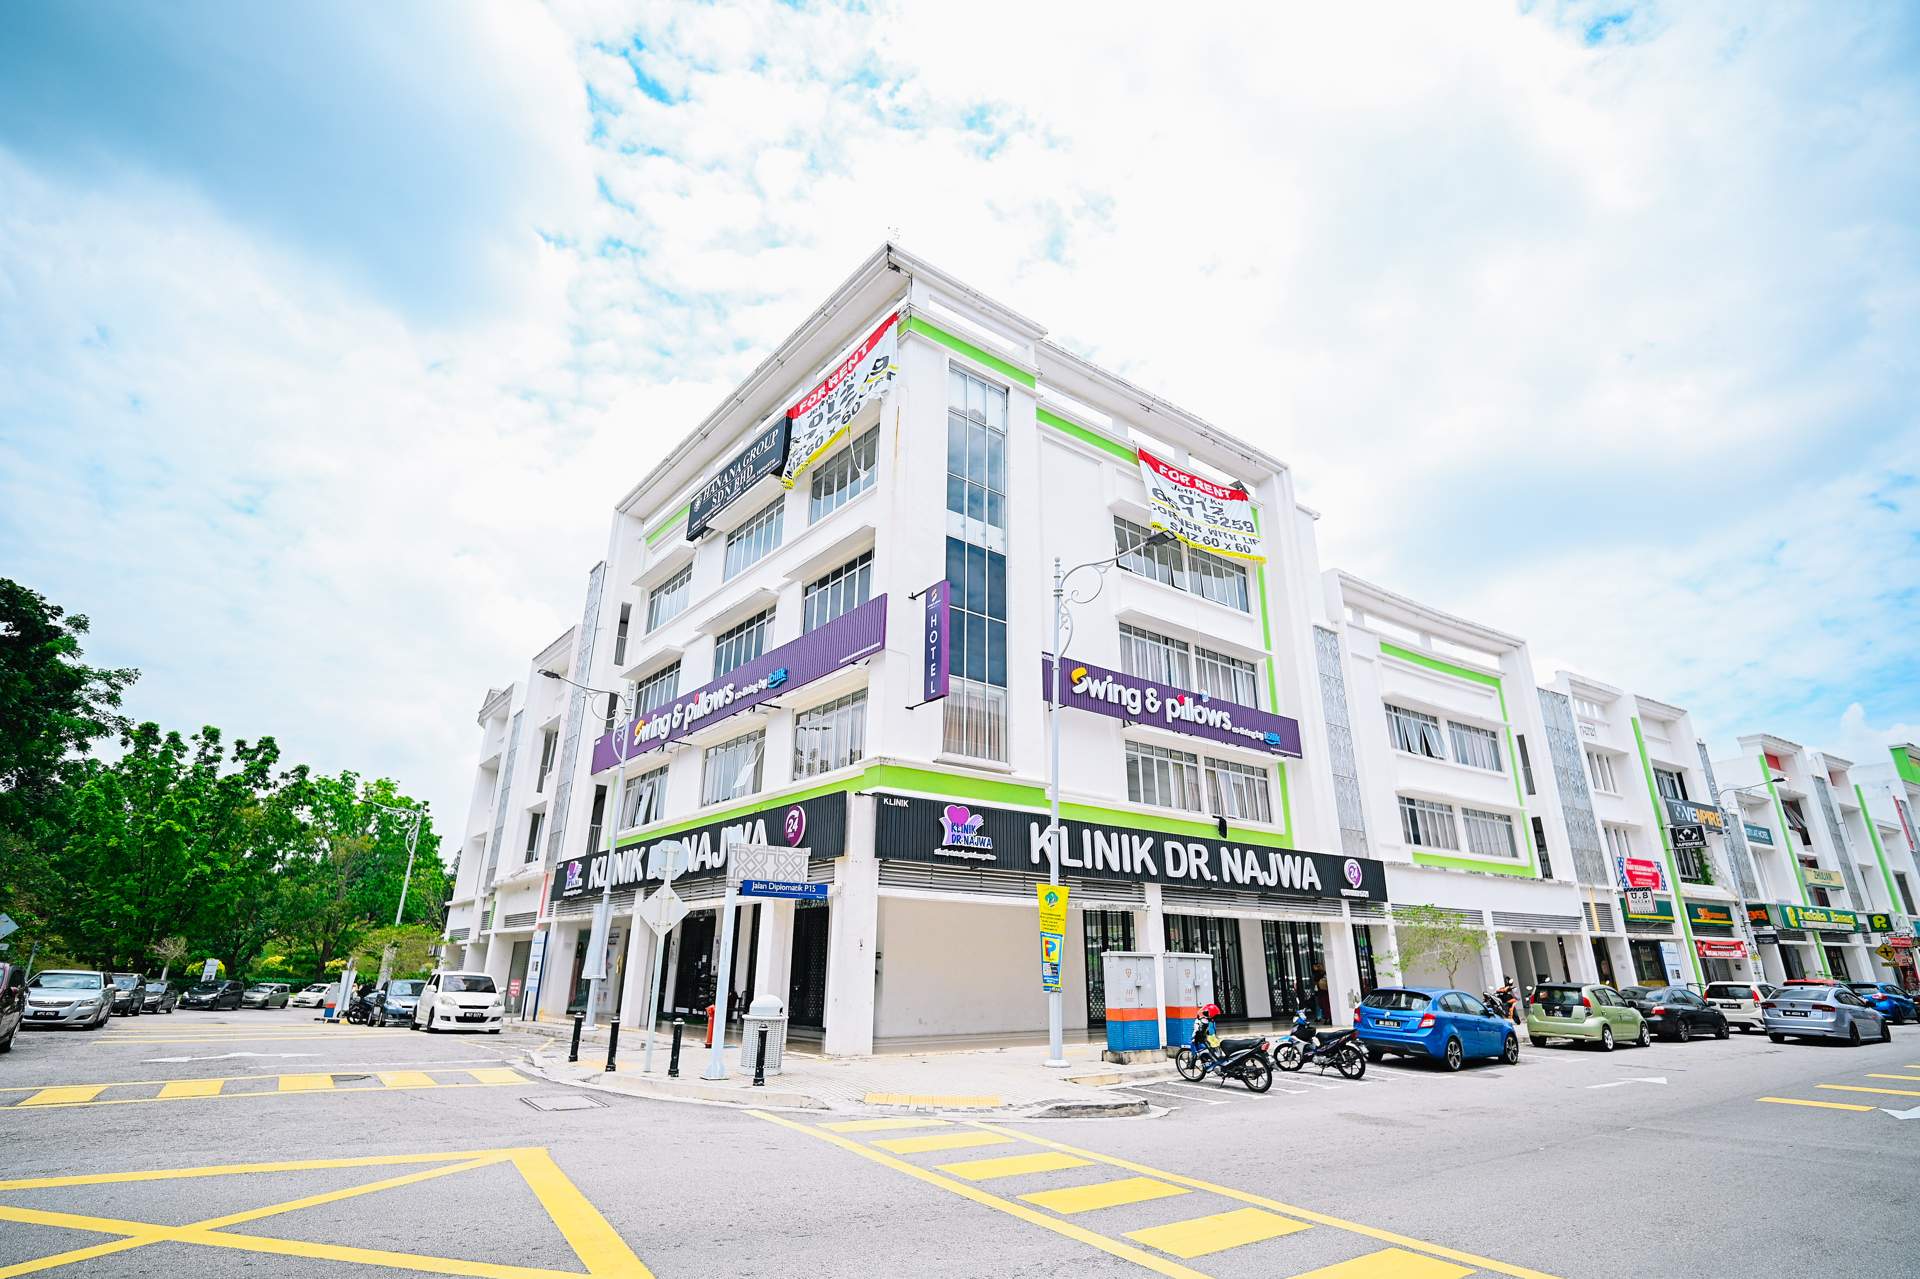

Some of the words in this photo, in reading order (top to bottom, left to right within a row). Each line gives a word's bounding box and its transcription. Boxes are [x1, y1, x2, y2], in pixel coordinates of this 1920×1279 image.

[799, 386, 826, 412] FOR
[829, 342, 869, 388] RENT
[841, 401, 861, 425] 60
[703, 462, 741, 501] HANANA
[742, 429, 779, 468] GROUP
[711, 483, 731, 508] SDN
[1159, 464, 1191, 486] FOR
[1194, 479, 1231, 499] RENT
[1170, 521, 1200, 543] SAIZ
[1202, 535, 1220, 548] 60
[1235, 543, 1251, 554] 60
[1203, 513, 1255, 533] 5259
[1208, 528, 1237, 541] WITH
[929, 613, 938, 694] HOTEL
[1071, 667, 1141, 716] Swing
[1145, 688, 1162, 713] &
[1165, 693, 1232, 731] pillows
[634, 711, 671, 746] Swing
[672, 703, 683, 729] &
[684, 682, 735, 730] pillows
[883, 798, 909, 808] KLINIK
[787, 817, 799, 833] 24
[951, 822, 977, 835] KLINIK
[964, 835, 992, 848] NAJWA
[1030, 821, 1157, 876] KLINIK
[1164, 840, 1218, 882] DR.
[1220, 846, 1322, 891] NAJWA
[588, 847, 646, 890] KLNIK
[752, 882, 767, 891] Jalan
[768, 883, 803, 892] Diplomatik
[804, 885, 816, 893] P15
